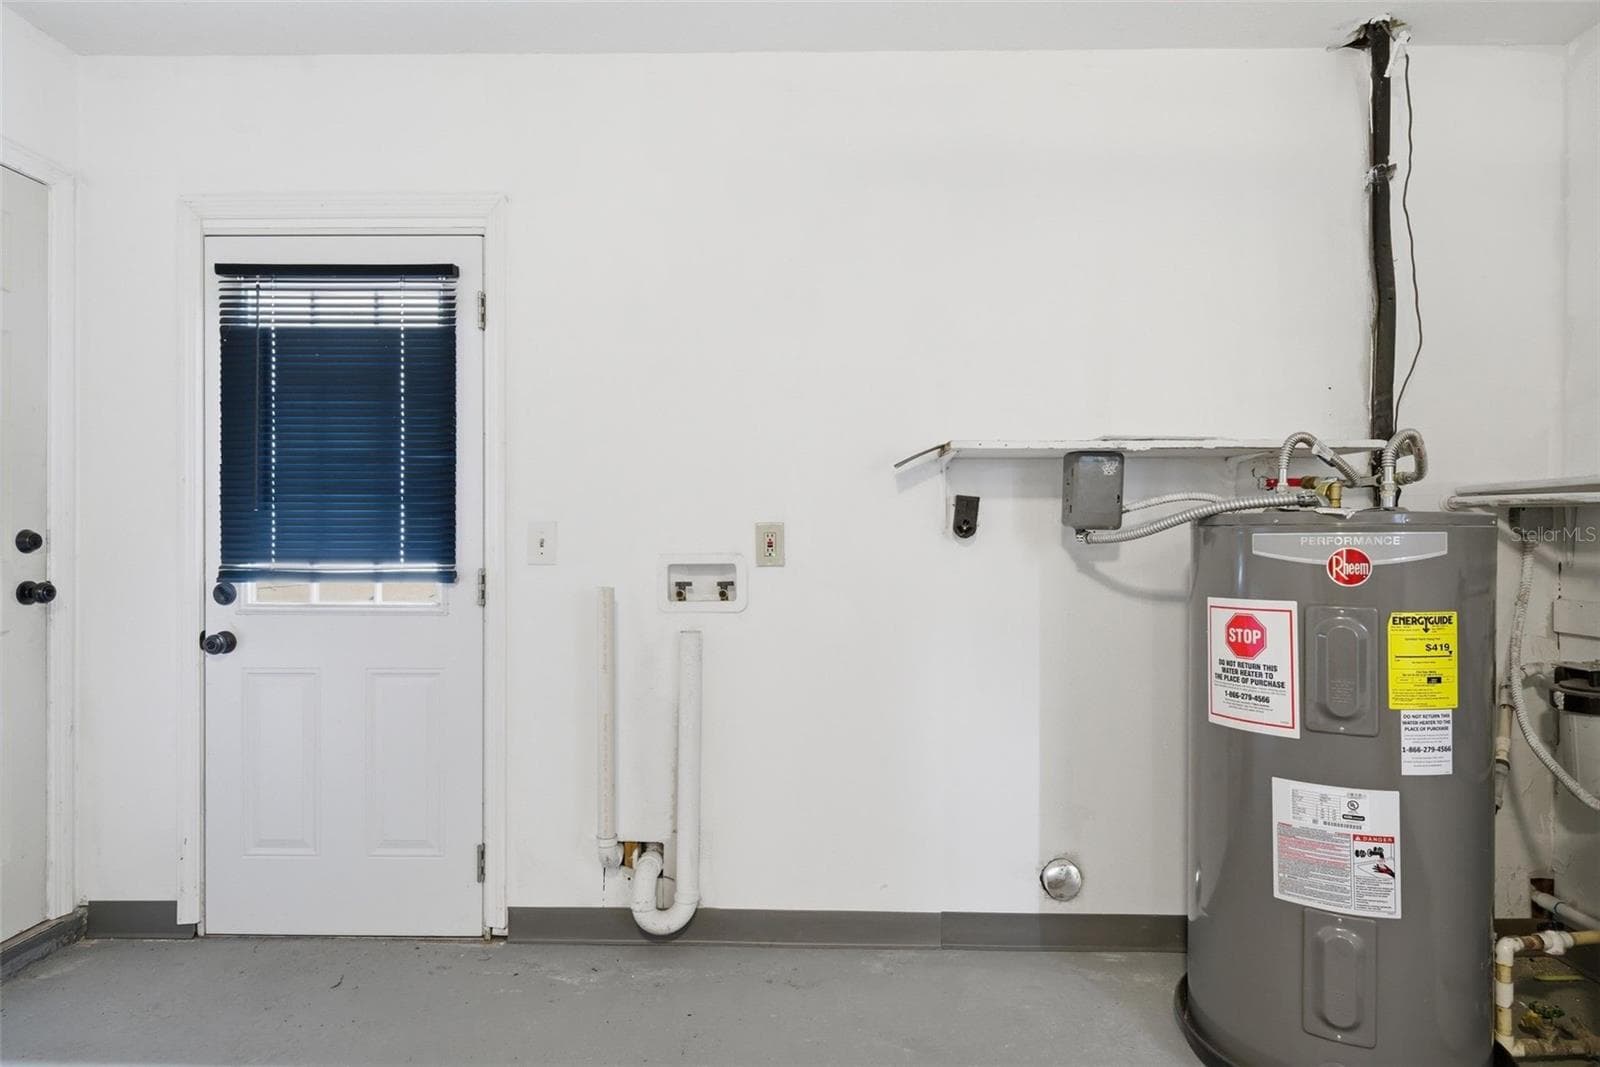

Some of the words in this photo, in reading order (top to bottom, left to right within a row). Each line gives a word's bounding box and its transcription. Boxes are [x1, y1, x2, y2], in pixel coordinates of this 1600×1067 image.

[1300, 536, 1400, 546] PERFORMANCE
[1332, 549, 1369, 580] Rheem
[1392, 616, 1453, 626] ENERGYGUIDE
[1228, 628, 1261, 644] STOP
[1425, 644, 1450, 652] $419
[1238, 661, 1260, 670] RETURN
[1221, 667, 1238, 675] WATER
[1240, 670, 1263, 678] HEATER
[1224, 674, 1240, 683] PLACE
[1250, 678, 1285, 688] PURCHASE
